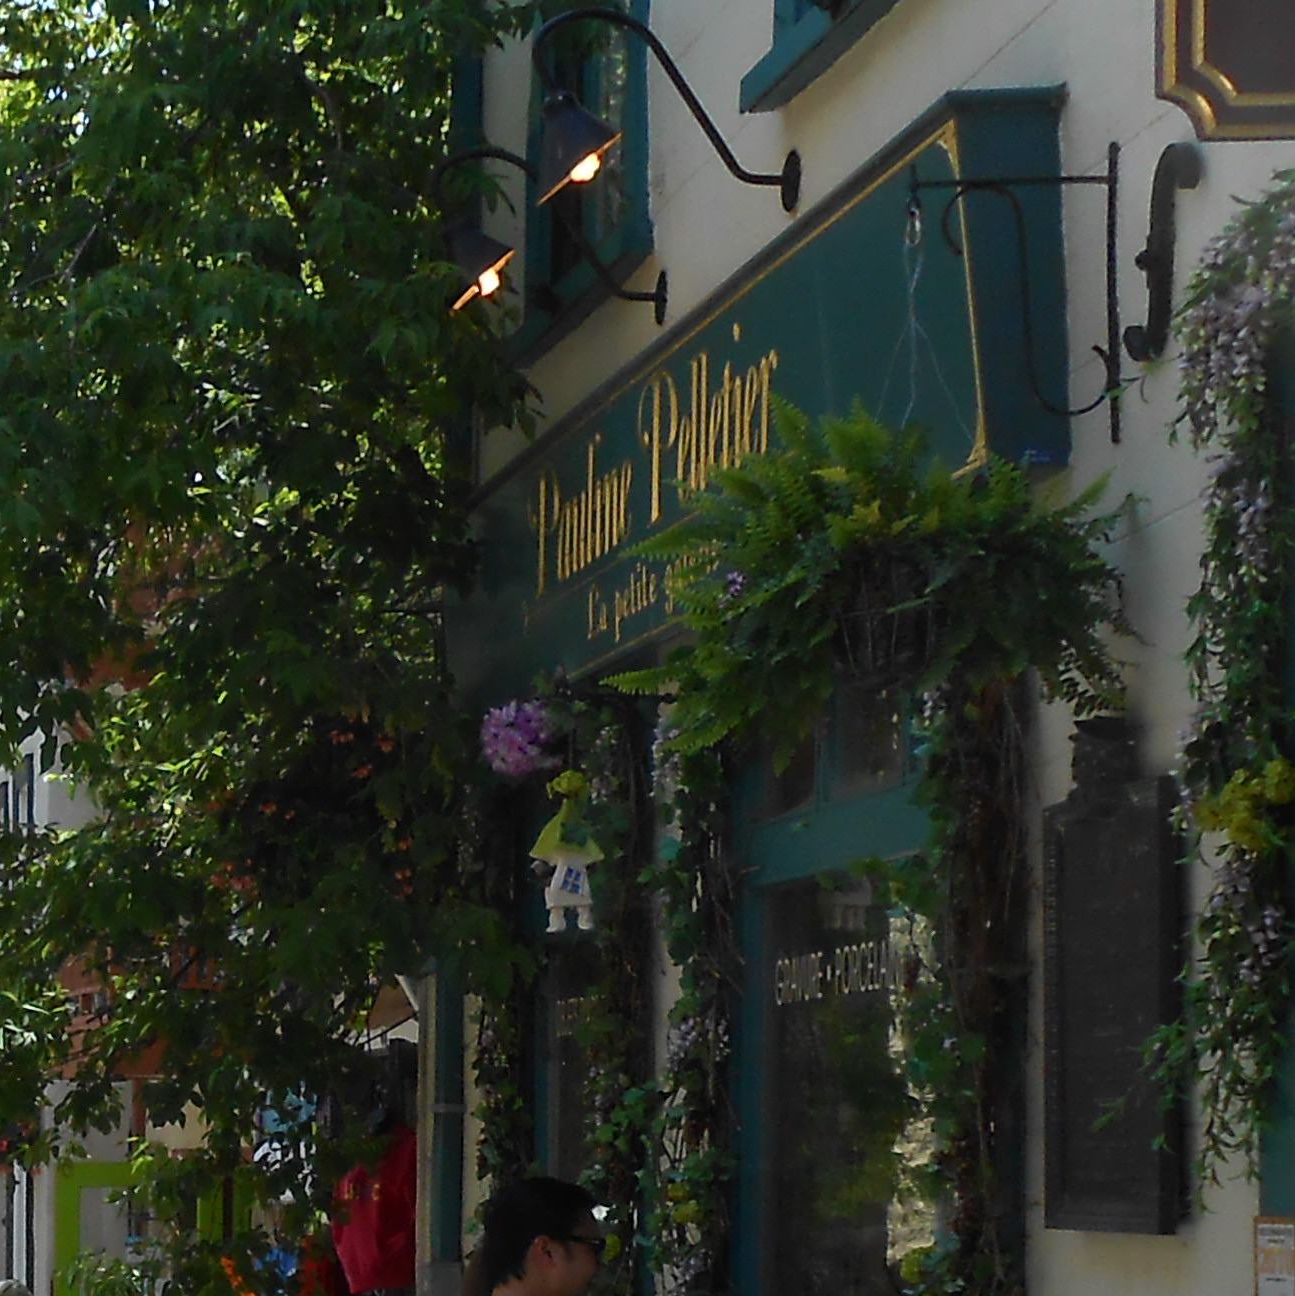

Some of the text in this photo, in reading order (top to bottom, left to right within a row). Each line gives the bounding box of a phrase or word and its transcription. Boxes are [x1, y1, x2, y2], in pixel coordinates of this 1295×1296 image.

[528, 433, 632, 599] Pauline
[638, 322, 779, 524] Pelletier
[587, 583, 608, 640] La
[615, 562, 657, 643] petite
